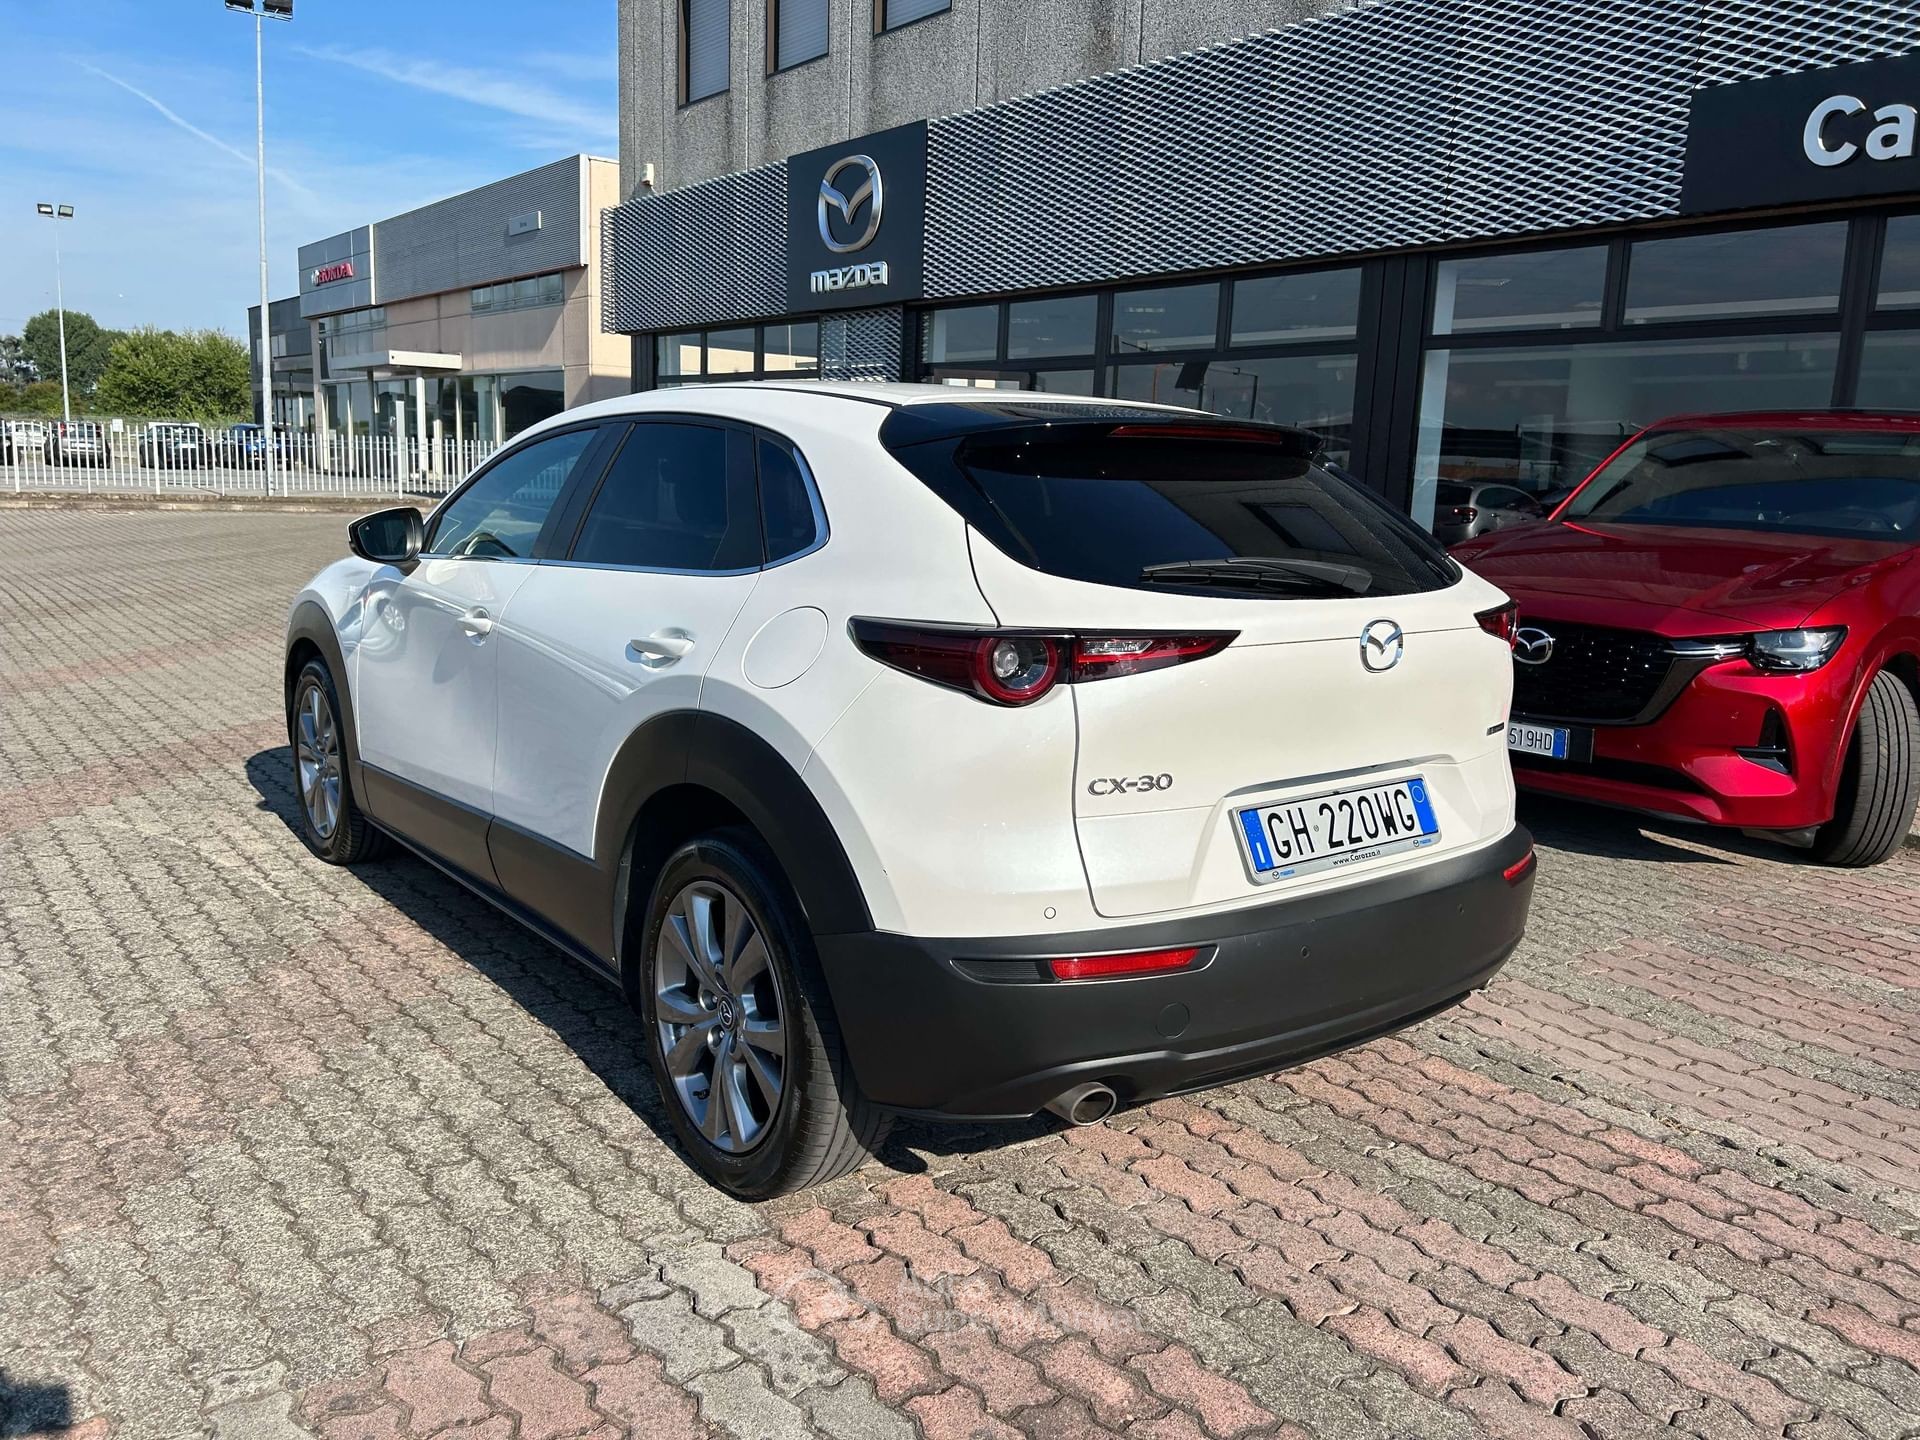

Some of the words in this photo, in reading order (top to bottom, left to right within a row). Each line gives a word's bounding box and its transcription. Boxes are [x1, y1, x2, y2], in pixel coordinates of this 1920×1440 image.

[1803, 95, 1918, 166] Ca
[1509, 728, 1553, 750] 519HD
[1087, 773, 1173, 796] CX-30
[1267, 807, 1315, 859] GH
[1319, 789, 1415, 849] 220WG
